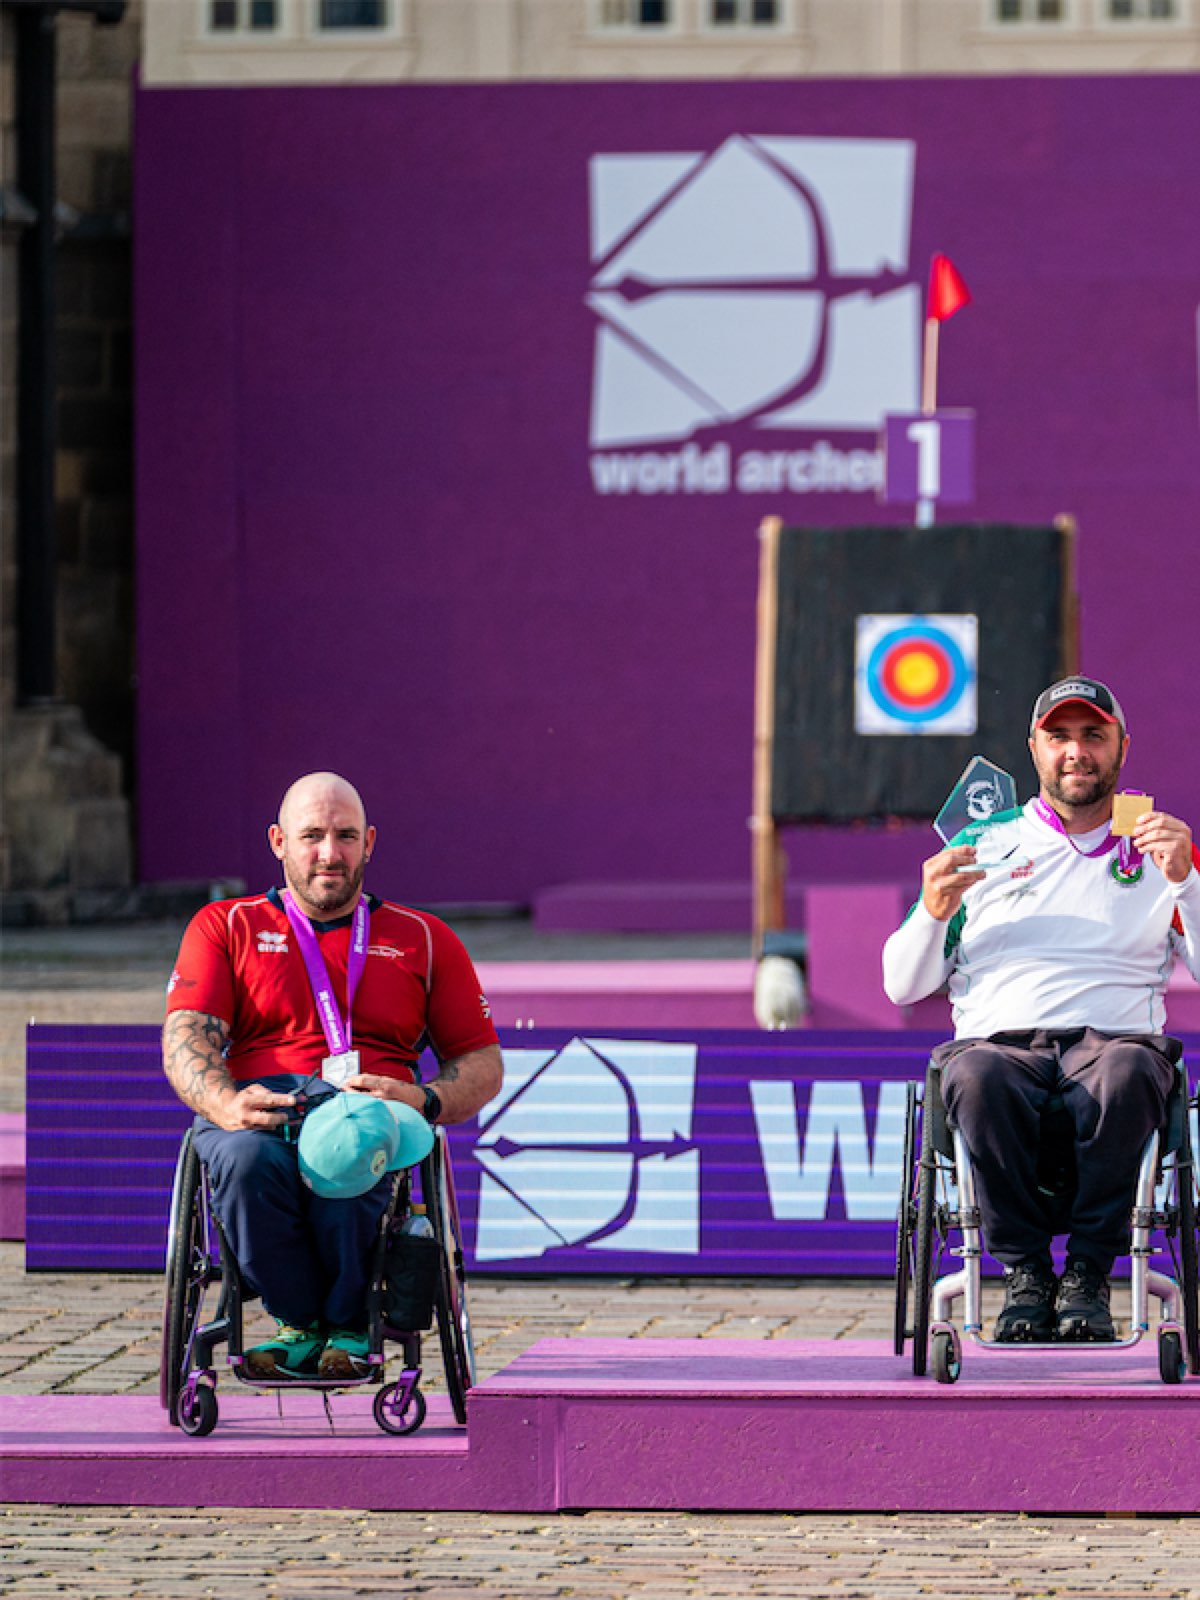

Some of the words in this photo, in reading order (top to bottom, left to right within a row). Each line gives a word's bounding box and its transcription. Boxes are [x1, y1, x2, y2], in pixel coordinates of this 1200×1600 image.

[592, 441, 730, 494] world
[736, 440, 884, 493] arche
[908, 421, 940, 496] 1
